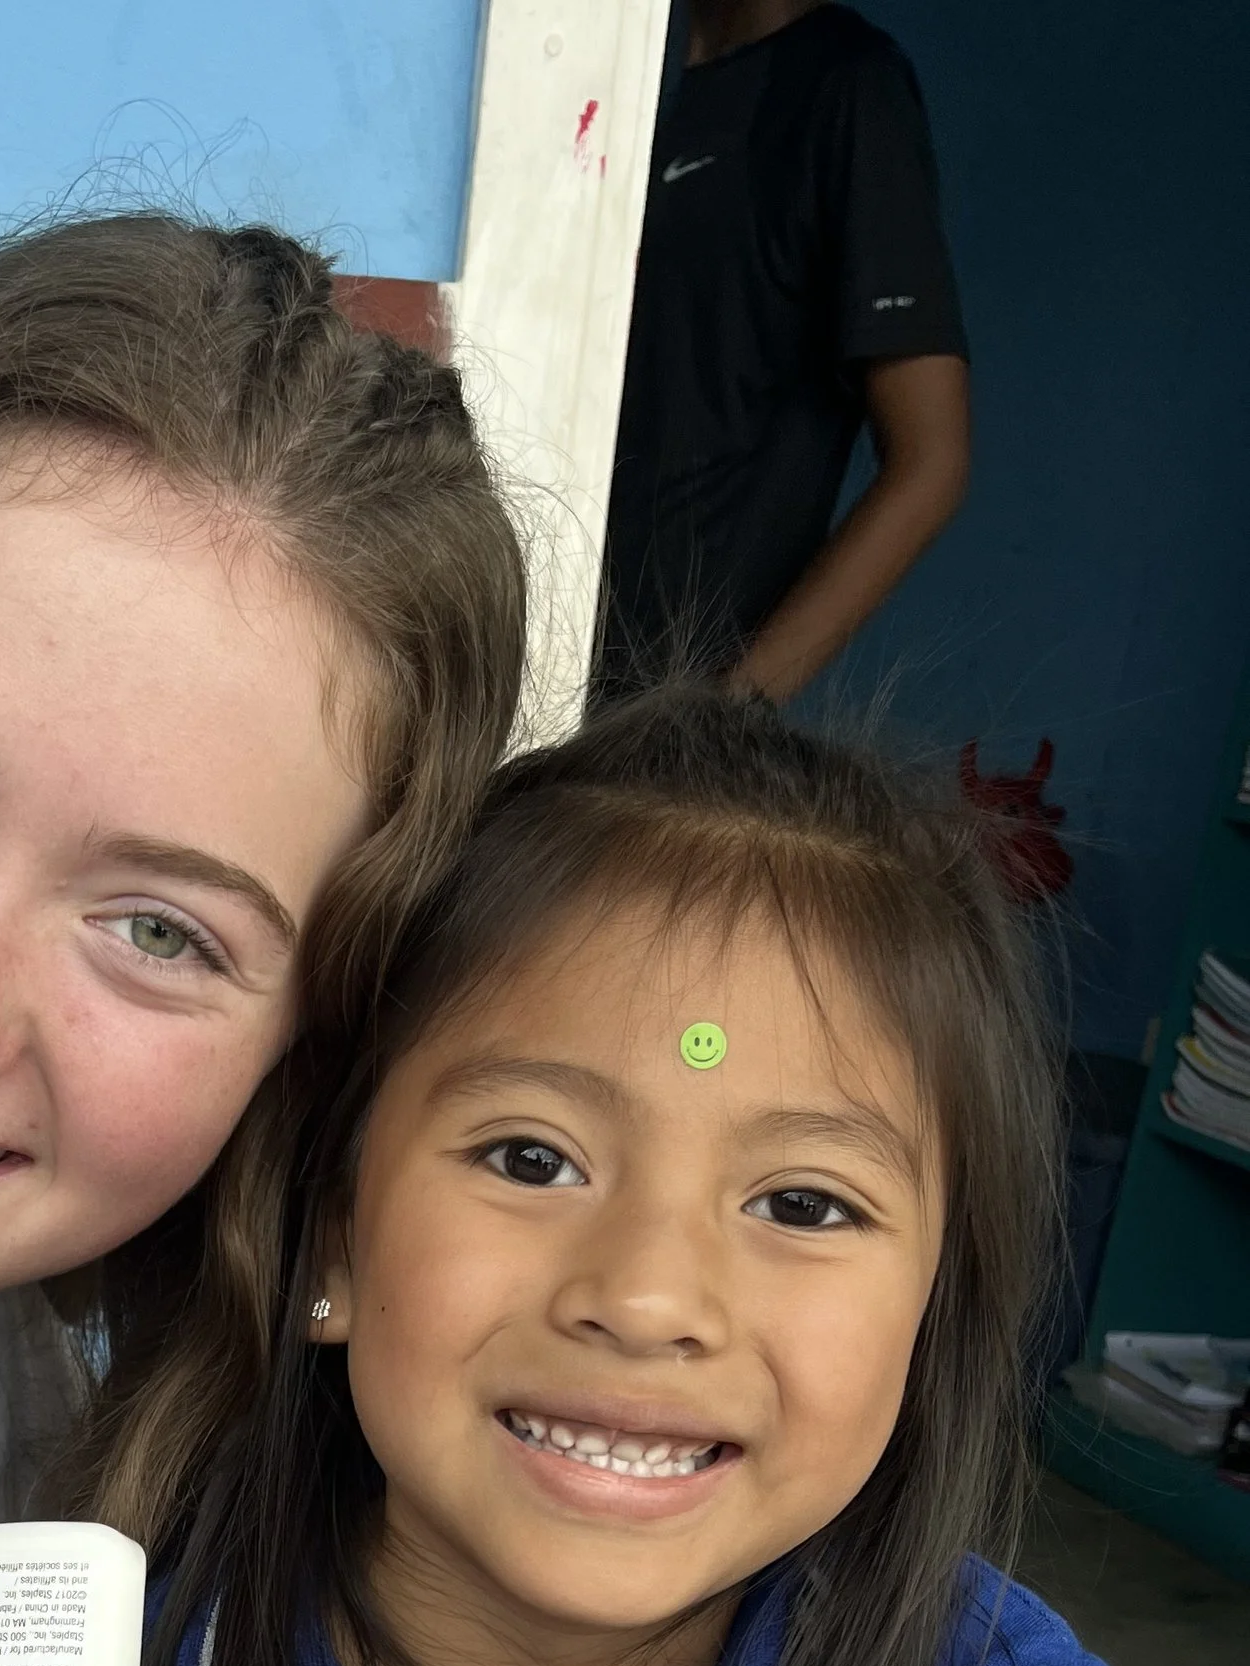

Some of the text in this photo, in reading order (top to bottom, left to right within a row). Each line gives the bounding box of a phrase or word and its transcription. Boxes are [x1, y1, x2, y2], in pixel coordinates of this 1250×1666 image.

[21, 1576, 56, 1585] affiliates
[72, 1577, 88, 1585] and
[25, 1604, 48, 1613] China
[52, 1604, 59, 1613] in
[62, 1604, 86, 1613] Made
[13, 1618, 26, 1627] MA
[29, 1616, 84, 1628] Framingham,
[11, 1632, 26, 1641] 500
[10, 1646, 21, 1655] for
[24, 1646, 83, 1655] Manufactured
